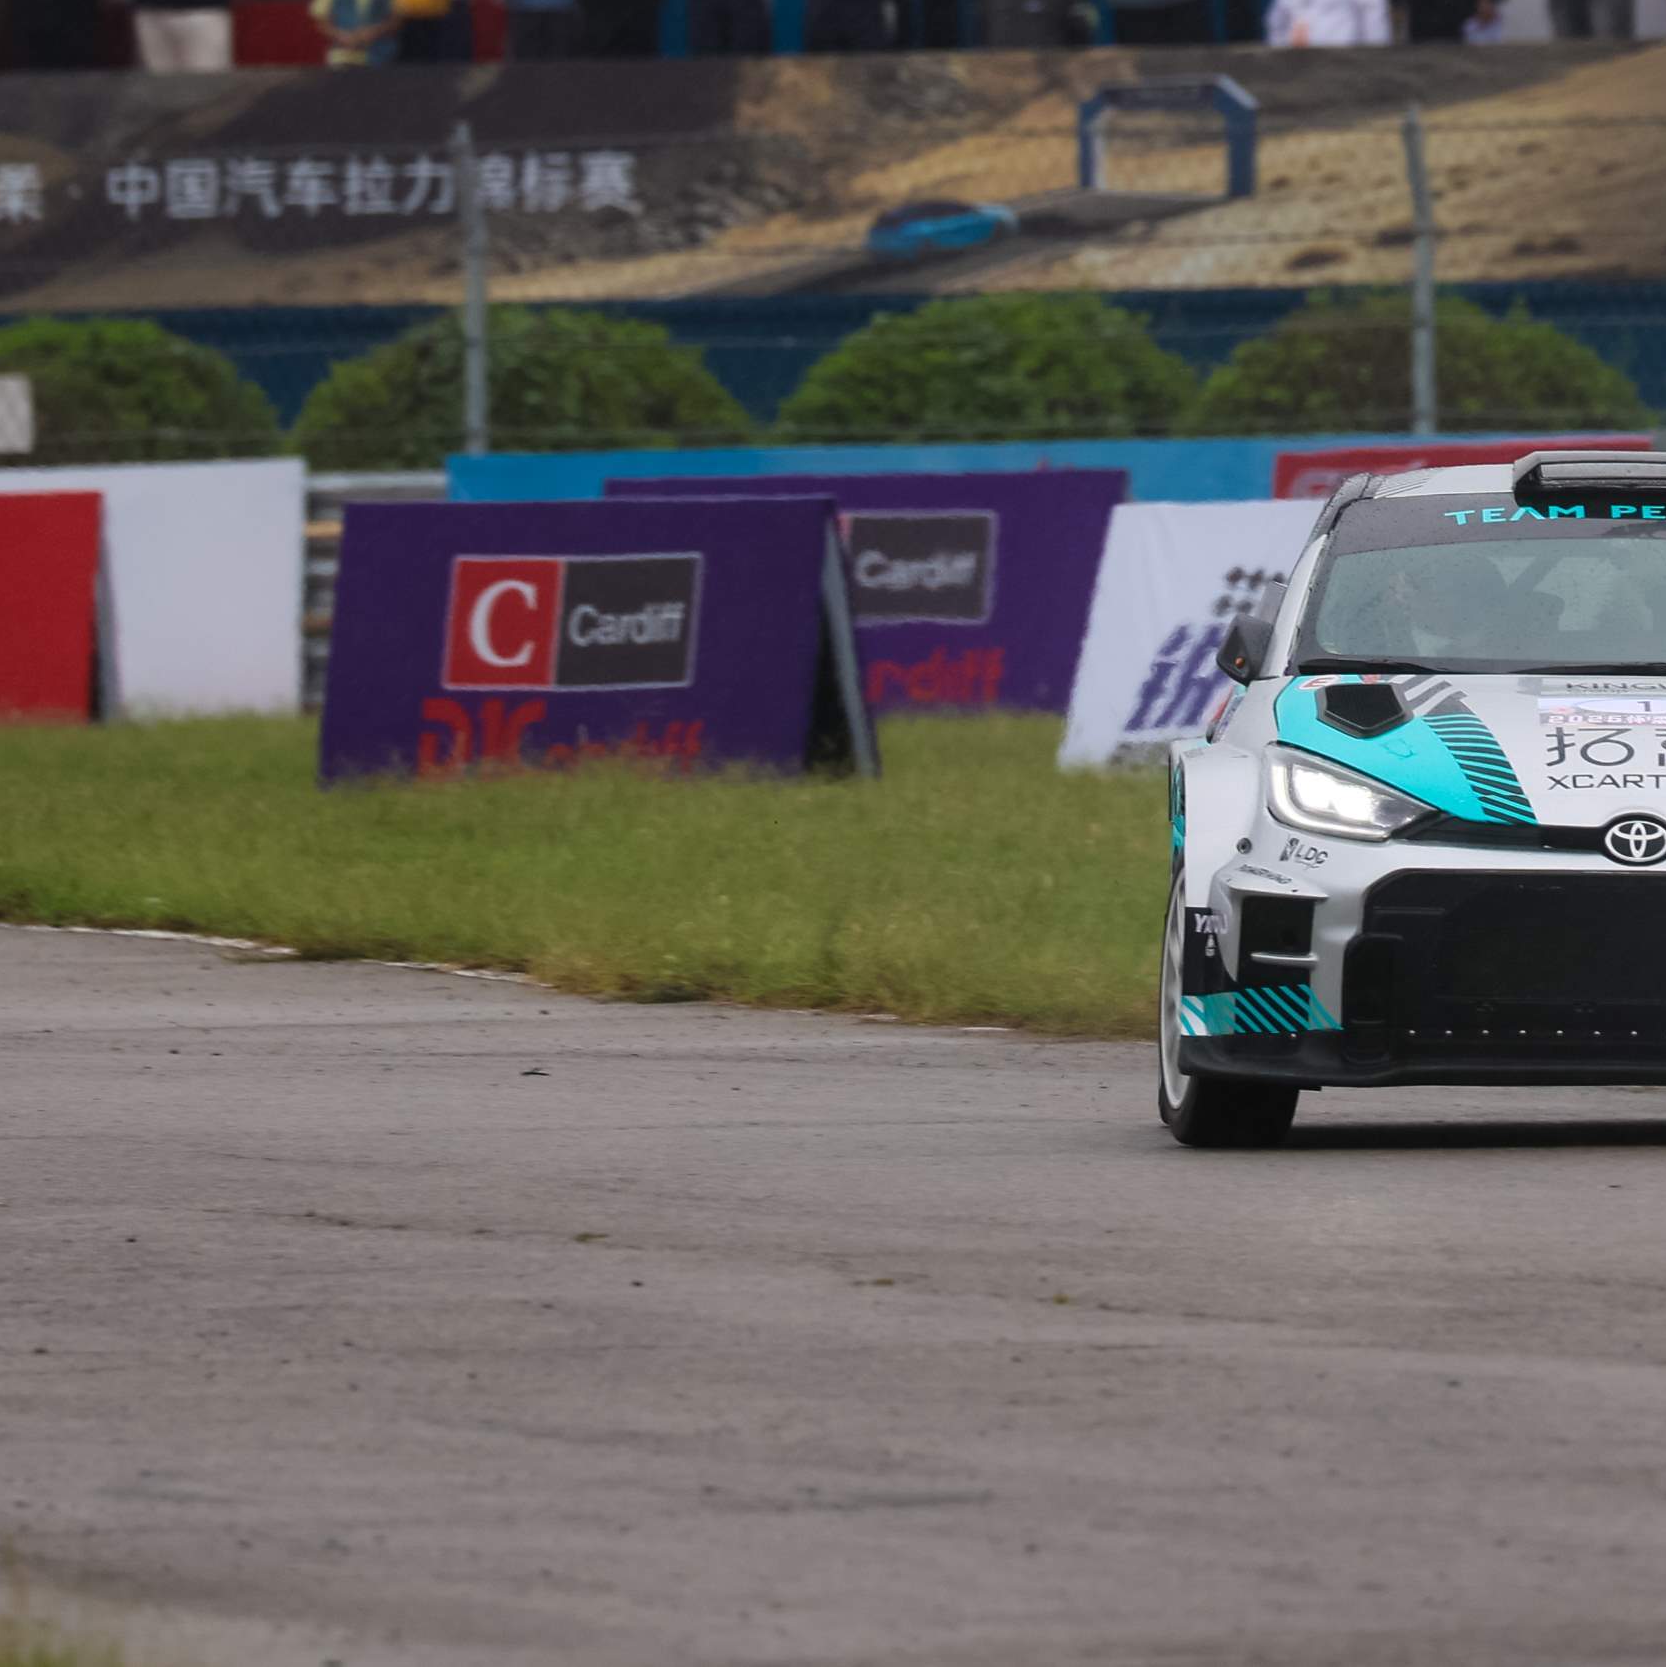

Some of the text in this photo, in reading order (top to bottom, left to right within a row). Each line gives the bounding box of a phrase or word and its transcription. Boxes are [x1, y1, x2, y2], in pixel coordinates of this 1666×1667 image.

[1444, 504, 1585, 527] TEAM
[855, 548, 980, 592] Cardiff
[468, 579, 686, 668] C Cardiff
[1636, 700, 1652, 713] 1
[1296, 845, 1329, 865] LDC
